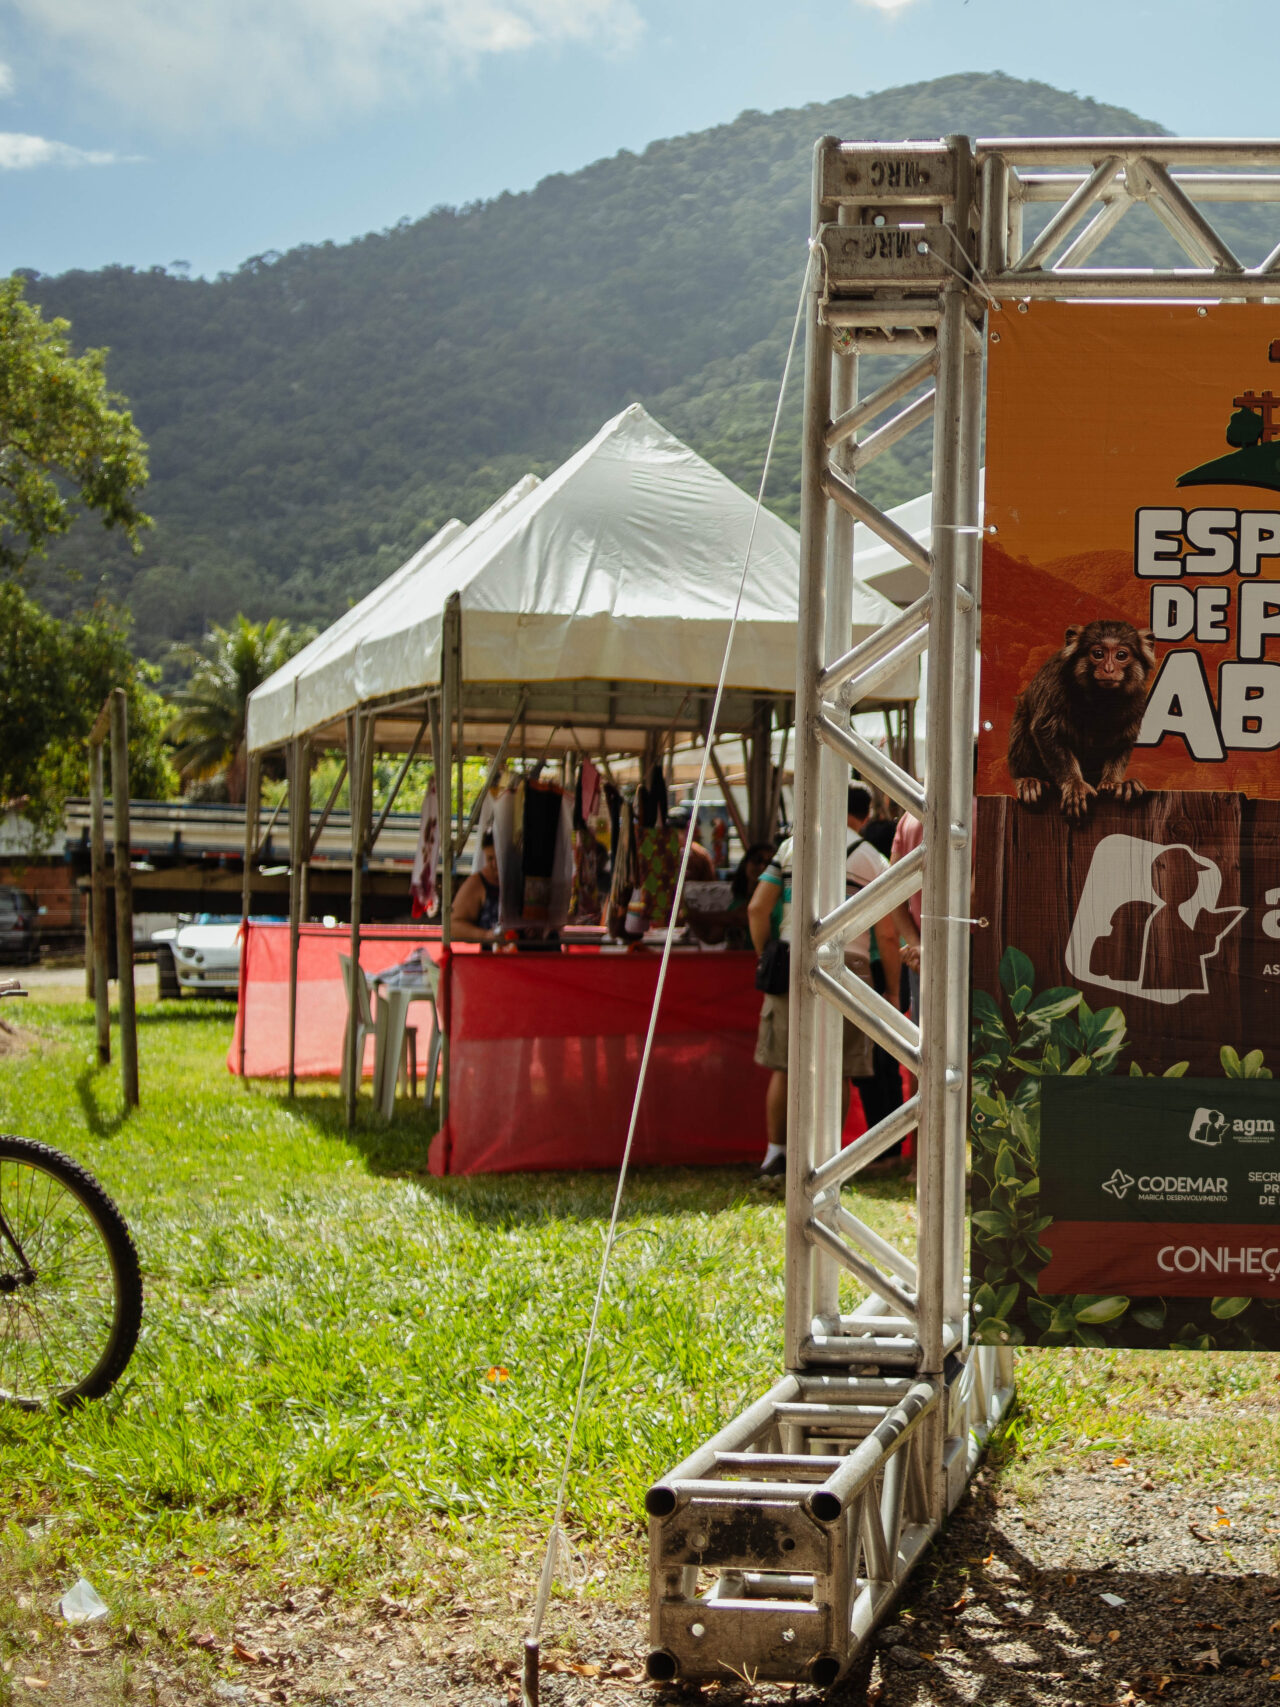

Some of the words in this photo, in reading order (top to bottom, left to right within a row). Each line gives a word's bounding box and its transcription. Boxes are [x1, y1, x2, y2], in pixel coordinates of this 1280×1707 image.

[1152, 586, 1229, 642] DE
[1232, 1119, 1275, 1135] agm
[1137, 1176, 1228, 1193] CODEMAR
[1138, 1193, 1164, 1201] MARICÁ
[1166, 1194, 1228, 1202] DESENVOLVIMENTO
[1259, 1195, 1276, 1205] DE
